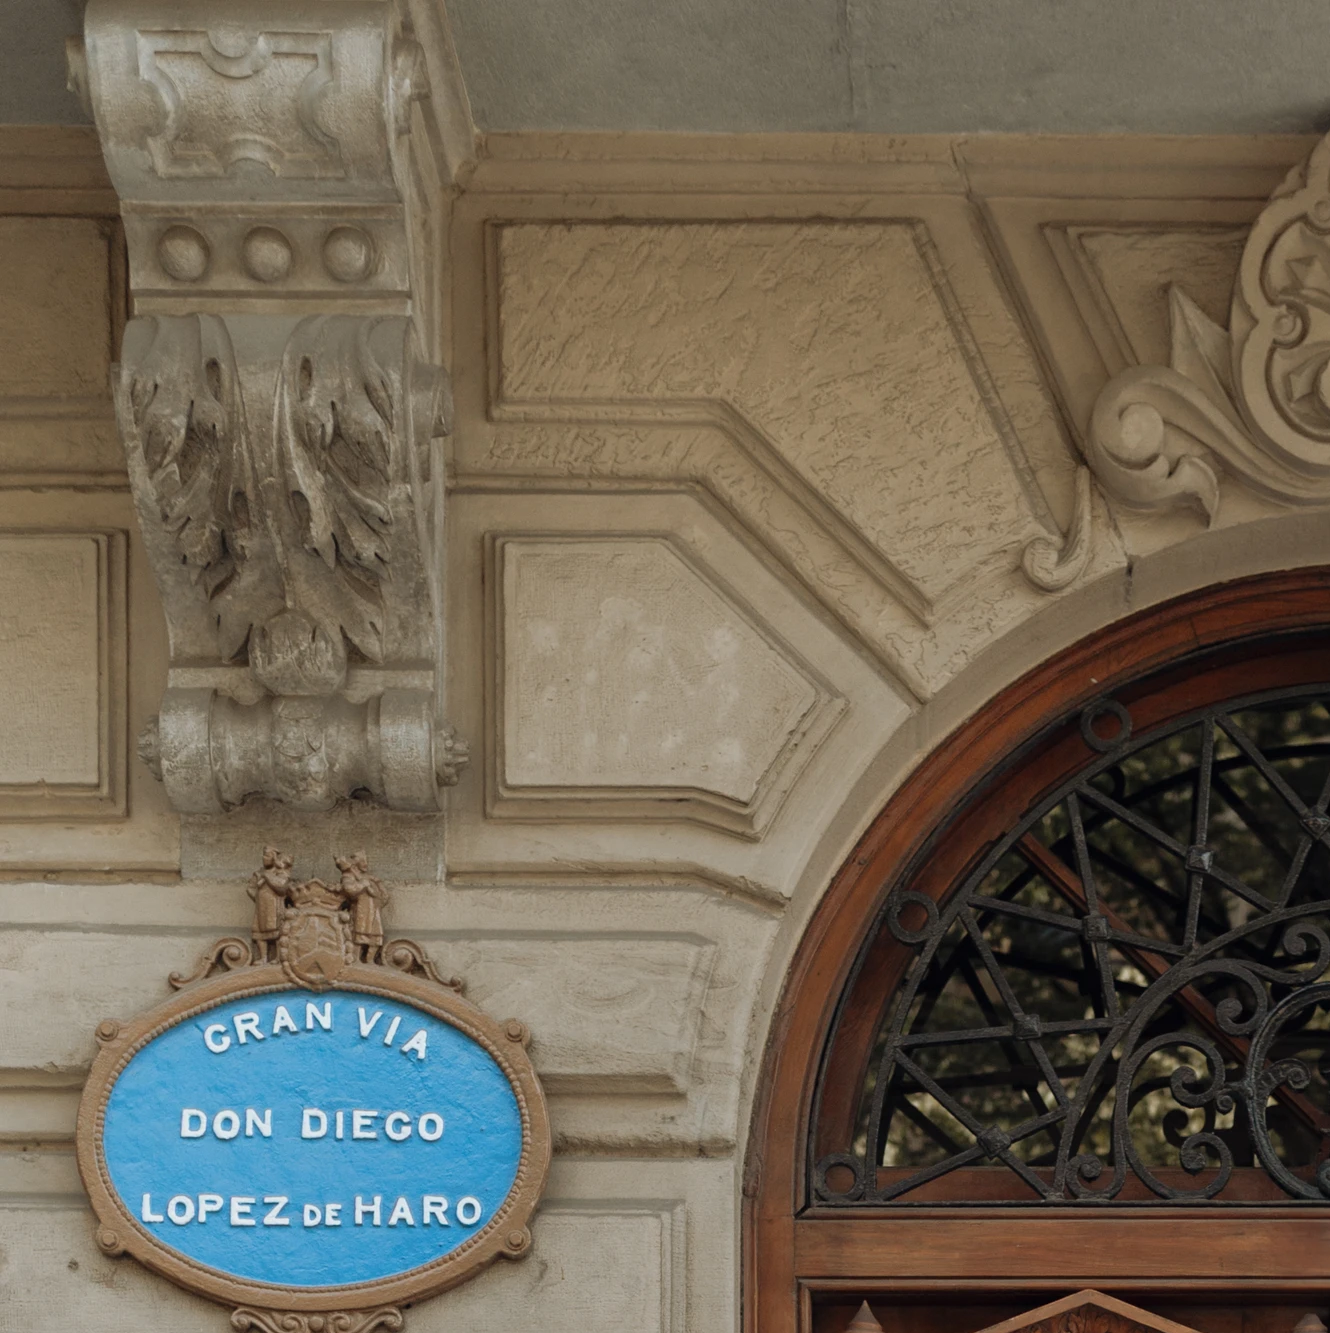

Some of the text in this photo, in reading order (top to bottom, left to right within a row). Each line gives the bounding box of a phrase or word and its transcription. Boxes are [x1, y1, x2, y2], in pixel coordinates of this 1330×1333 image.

[203, 1001, 429, 1060] GRAN VIA
[180, 1107, 445, 1142] DON DIEGO
[141, 1192, 483, 1228] LOPEZ DE HARO
